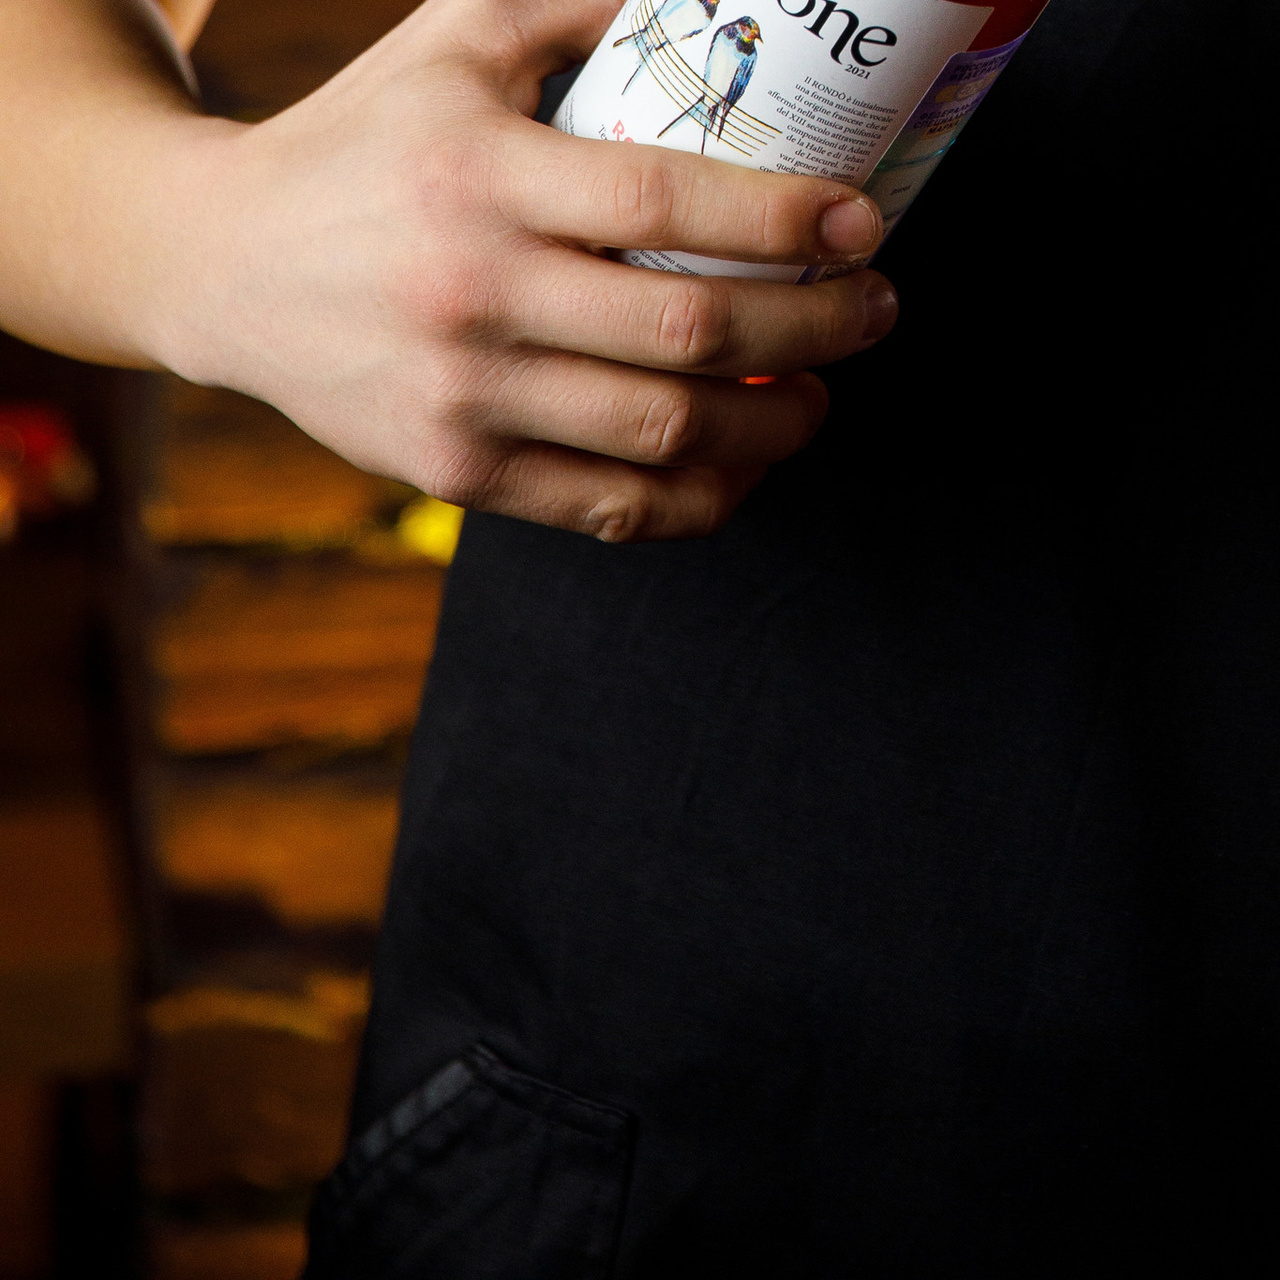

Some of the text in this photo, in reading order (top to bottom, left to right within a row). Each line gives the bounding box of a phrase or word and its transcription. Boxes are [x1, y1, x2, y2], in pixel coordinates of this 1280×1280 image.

[844, 63, 871, 80] 2021
[794, 94, 804, 103] di
[803, 100, 831, 116] origine
[831, 111, 864, 126] francese
[865, 122, 880, 131] che
[795, 83, 893, 123] una forma musicale vocale
[811, 80, 846, 100] RONDÒ
[852, 98, 899, 114] inizialmente
[767, 89, 882, 139] affermò nella musica polifonica
[776, 107, 790, 117] del
[789, 113, 807, 126] XIII
[806, 123, 830, 136] secolo
[830, 132, 868, 146] attraverso
[786, 134, 796, 143] de
[796, 138, 804, 147] la
[805, 142, 826, 155] Halle
[832, 151, 842, 159] di
[787, 124, 871, 156] composizioni di Adam
[779, 153, 795, 163] vari
[793, 160, 819, 172] generi
[820, 167, 829, 175] fu
[830, 171, 855, 180] questo
[794, 149, 805, 158] de
[842, 163, 855, 172] Fra
